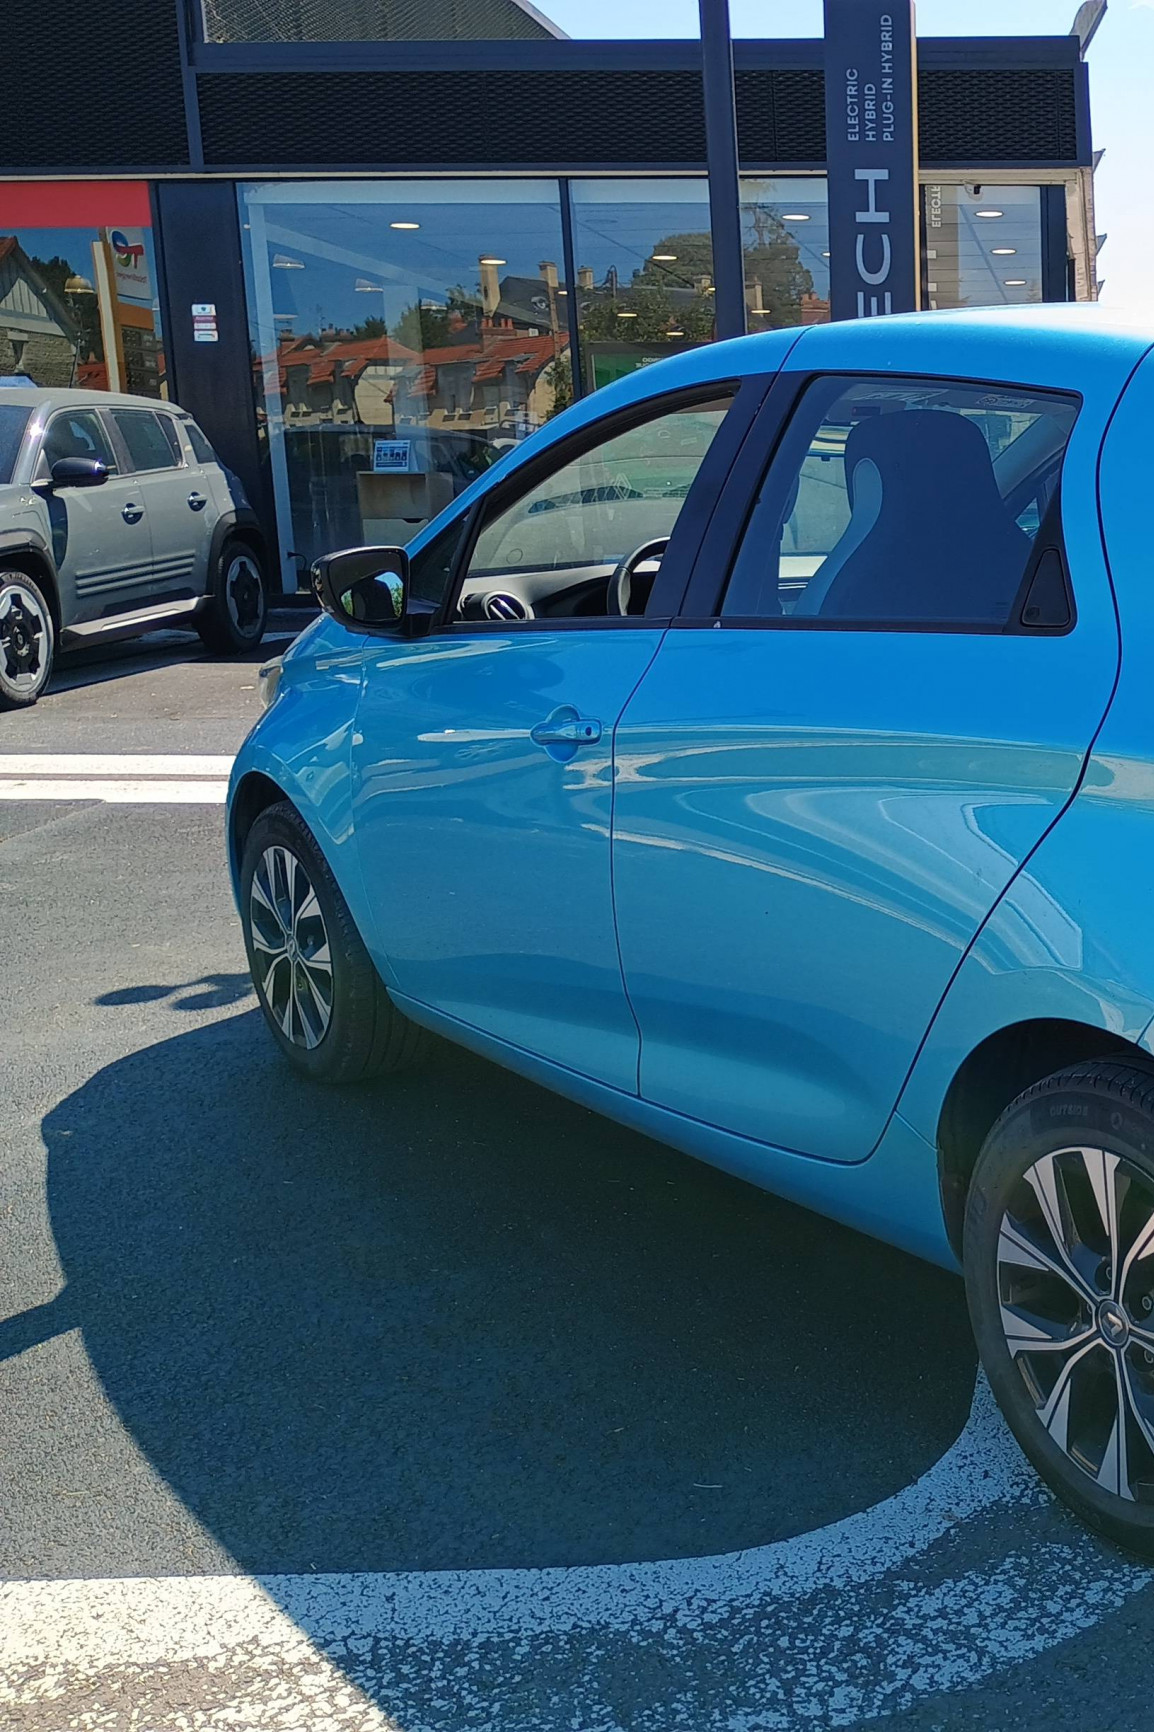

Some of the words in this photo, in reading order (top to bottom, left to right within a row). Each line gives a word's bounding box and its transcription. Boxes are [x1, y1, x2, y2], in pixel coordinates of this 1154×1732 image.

[880, 14, 894, 74] HYBRID
[847, 67, 859, 141] ELECTRIC
[865, 82, 877, 142] HYBRID
[882, 77, 895, 142] PLUG-IN
